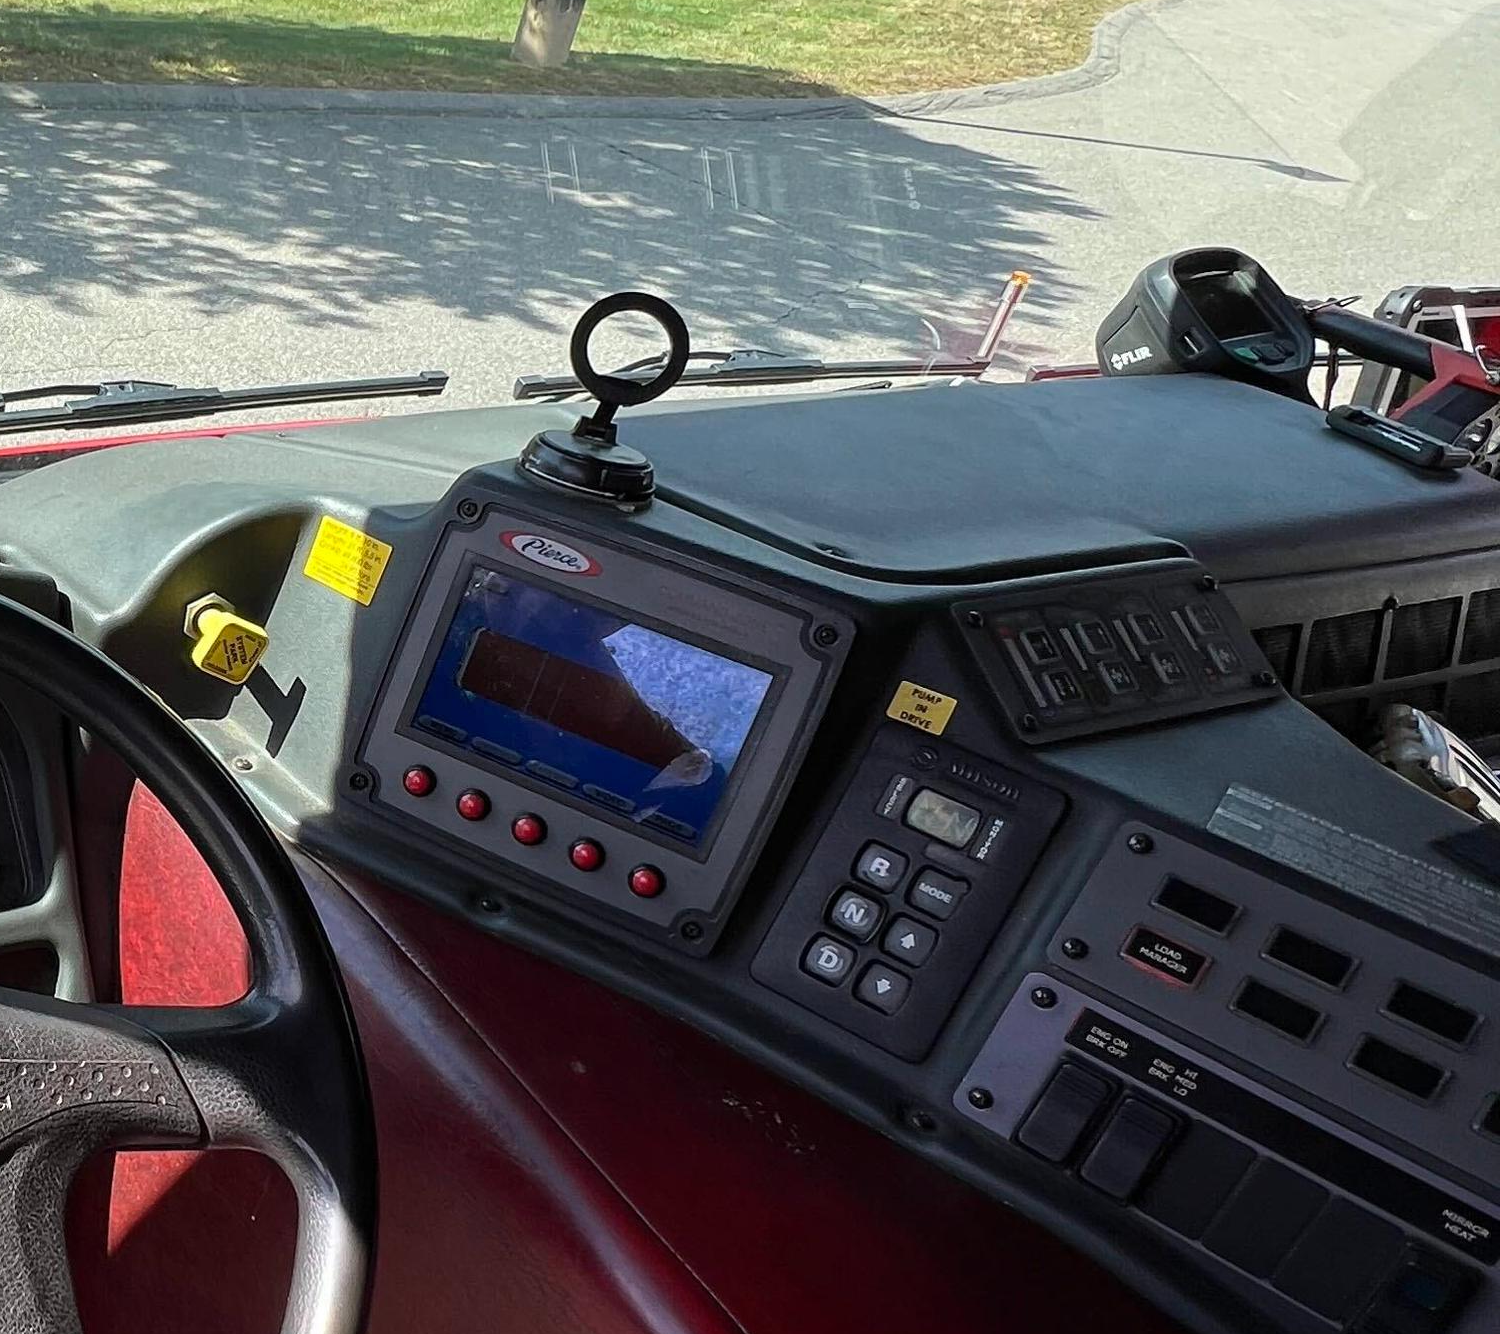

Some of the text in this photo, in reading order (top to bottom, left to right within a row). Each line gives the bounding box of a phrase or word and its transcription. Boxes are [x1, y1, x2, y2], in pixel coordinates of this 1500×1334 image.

[1121, 346, 1152, 365] FLIR
[521, 538, 578, 567] Pierce
[911, 688, 942, 704] PUMP
[915, 703, 928, 713] IN
[900, 711, 932, 729] DRIVE
[976, 818, 1004, 861] MONITOR
[869, 856, 891, 877] R
[919, 882, 953, 904] MODE
[843, 903, 865, 924] N
[818, 949, 839, 969] D
[1140, 947, 1188, 974] MANAGER
[1154, 943, 1182, 960] LOAD
[1085, 1034, 1128, 1059] BRK OFF
[1112, 1037, 1129, 1050] ON
[1148, 1067, 1197, 1090] BRK MED
[1173, 1085, 1188, 1096] LO
[1441, 1208, 1490, 1238] MIRROR
[1444, 1222, 1477, 1242] HEAT
